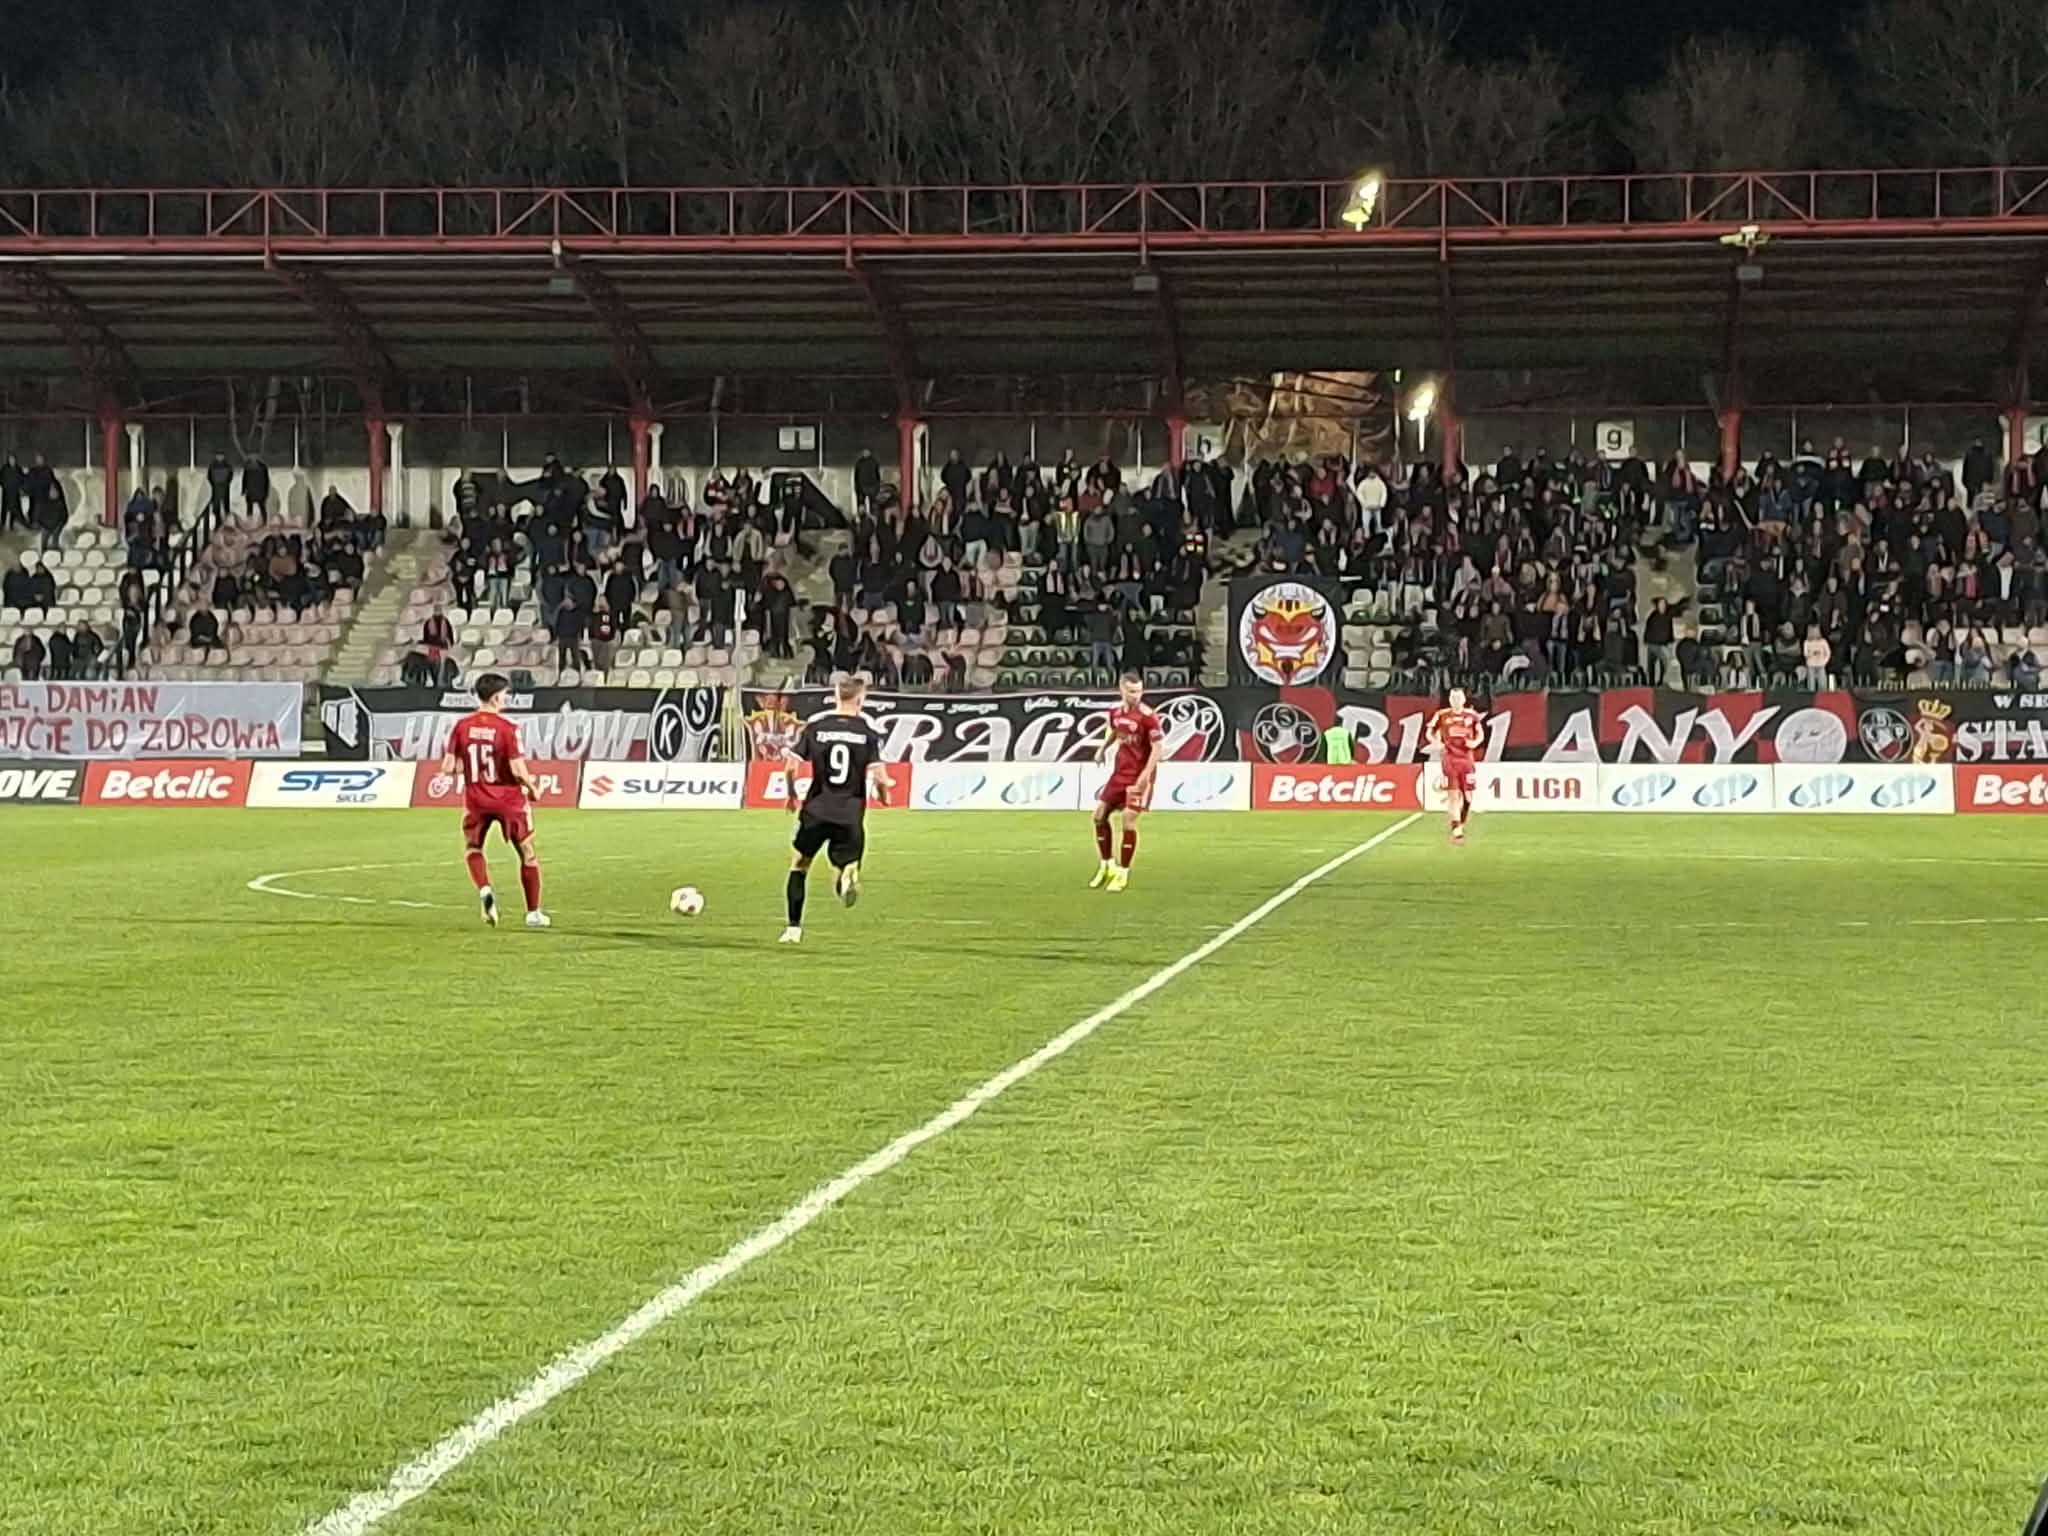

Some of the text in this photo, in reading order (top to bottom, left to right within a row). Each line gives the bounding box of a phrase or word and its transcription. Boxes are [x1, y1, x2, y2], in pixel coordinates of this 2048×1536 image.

[86, 718, 128, 752] DO
[467, 742, 497, 784] 15
[829, 743, 850, 785] 9
[100, 767, 234, 800] Betclic
[622, 778, 739, 795] SUZUKI
[1268, 773, 1397, 803] Betclic
[1488, 777, 1582, 800] 1 LIGA
